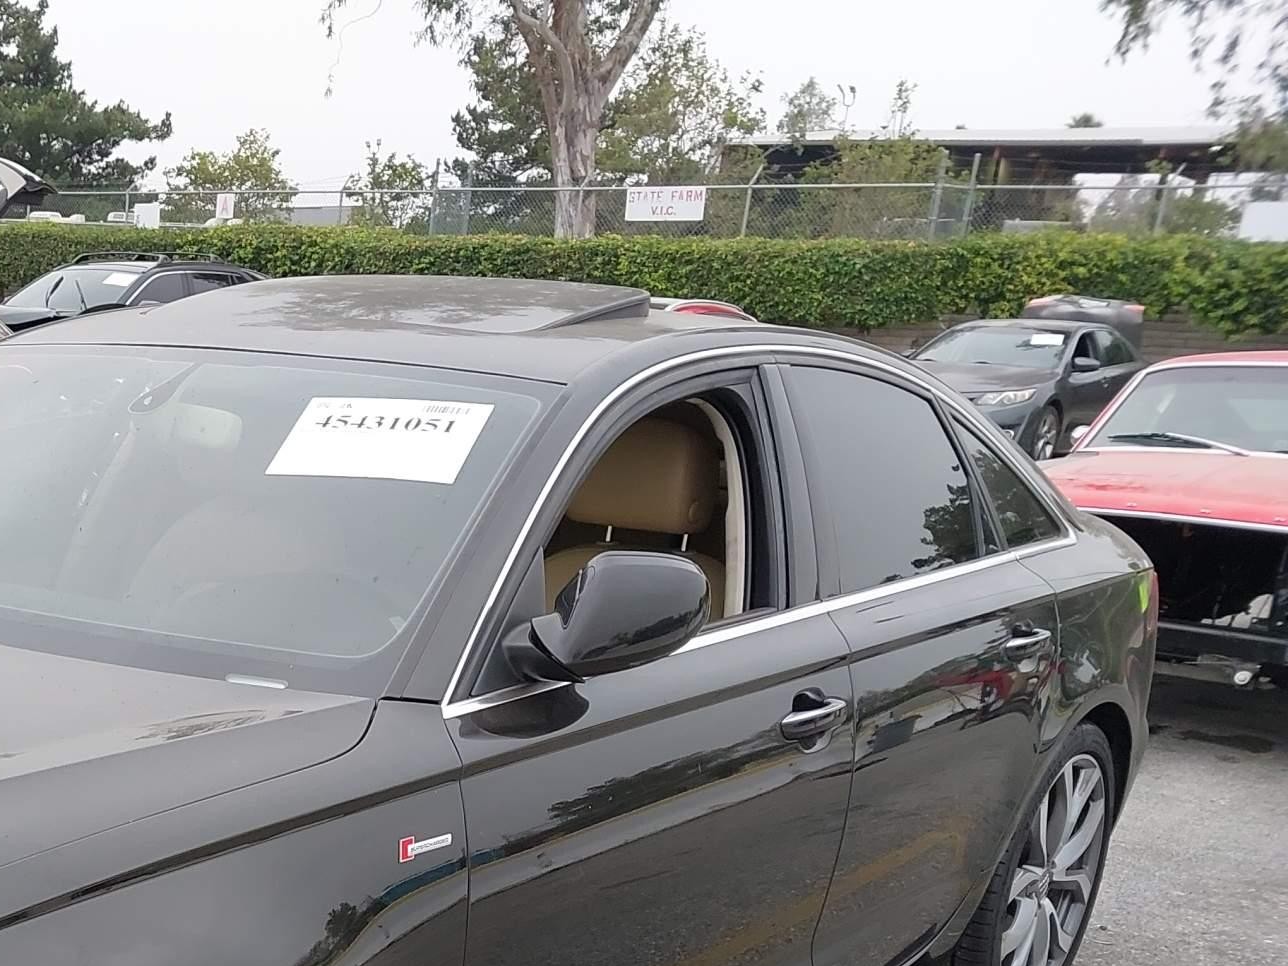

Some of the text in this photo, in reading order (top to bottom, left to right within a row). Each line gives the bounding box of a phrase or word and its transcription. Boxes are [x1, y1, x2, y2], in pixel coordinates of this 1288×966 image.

[628, 189, 704, 203] STATE FARM
[650, 205, 677, 216] V.I.C.
[314, 415, 456, 433] 45431051
